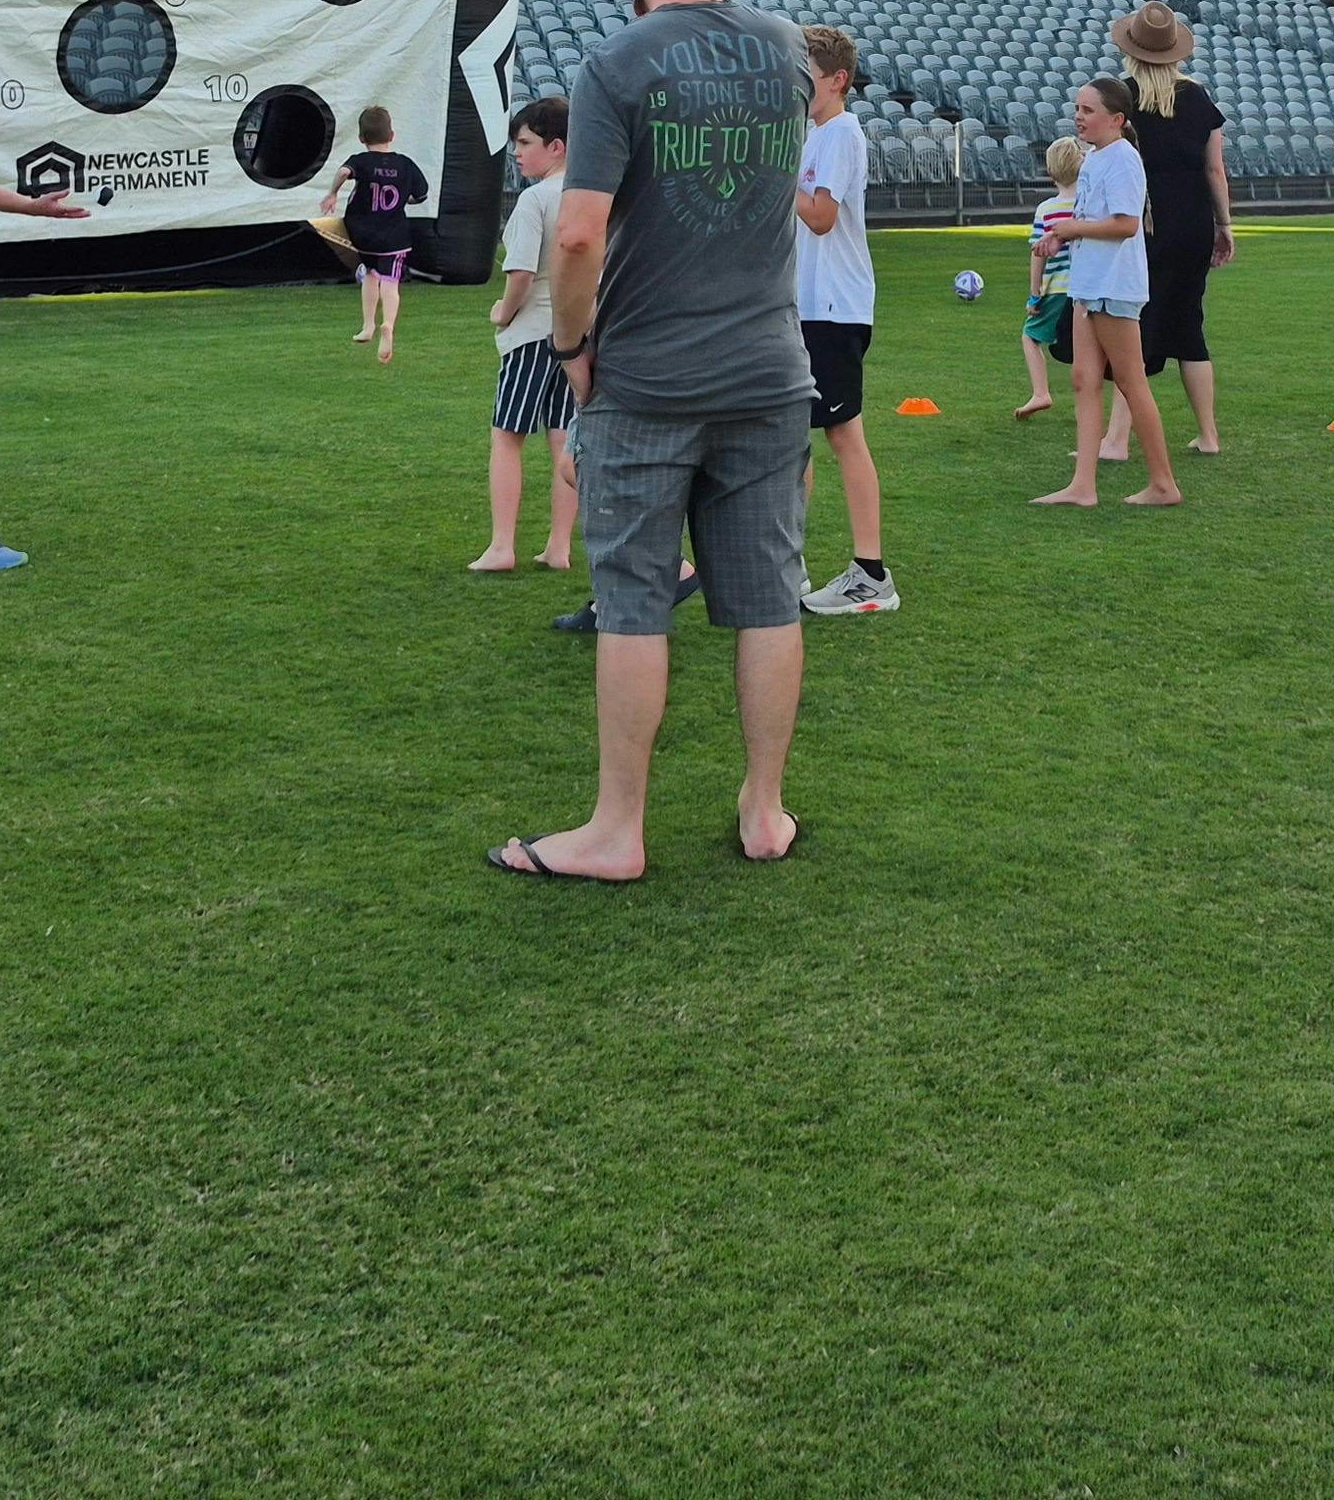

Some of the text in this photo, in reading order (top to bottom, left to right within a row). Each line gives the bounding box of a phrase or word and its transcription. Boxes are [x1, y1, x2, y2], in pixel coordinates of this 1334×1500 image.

[648, 30, 798, 76] VOLCOM
[204, 73, 249, 103] 10
[649, 90, 667, 109] 19
[677, 79, 747, 119] STONE
[88, 149, 210, 171] NEWCASTLE
[649, 113, 806, 178] TRUE TO THIS
[88, 170, 210, 192] PERMANENT
[369, 181, 400, 212] 10
